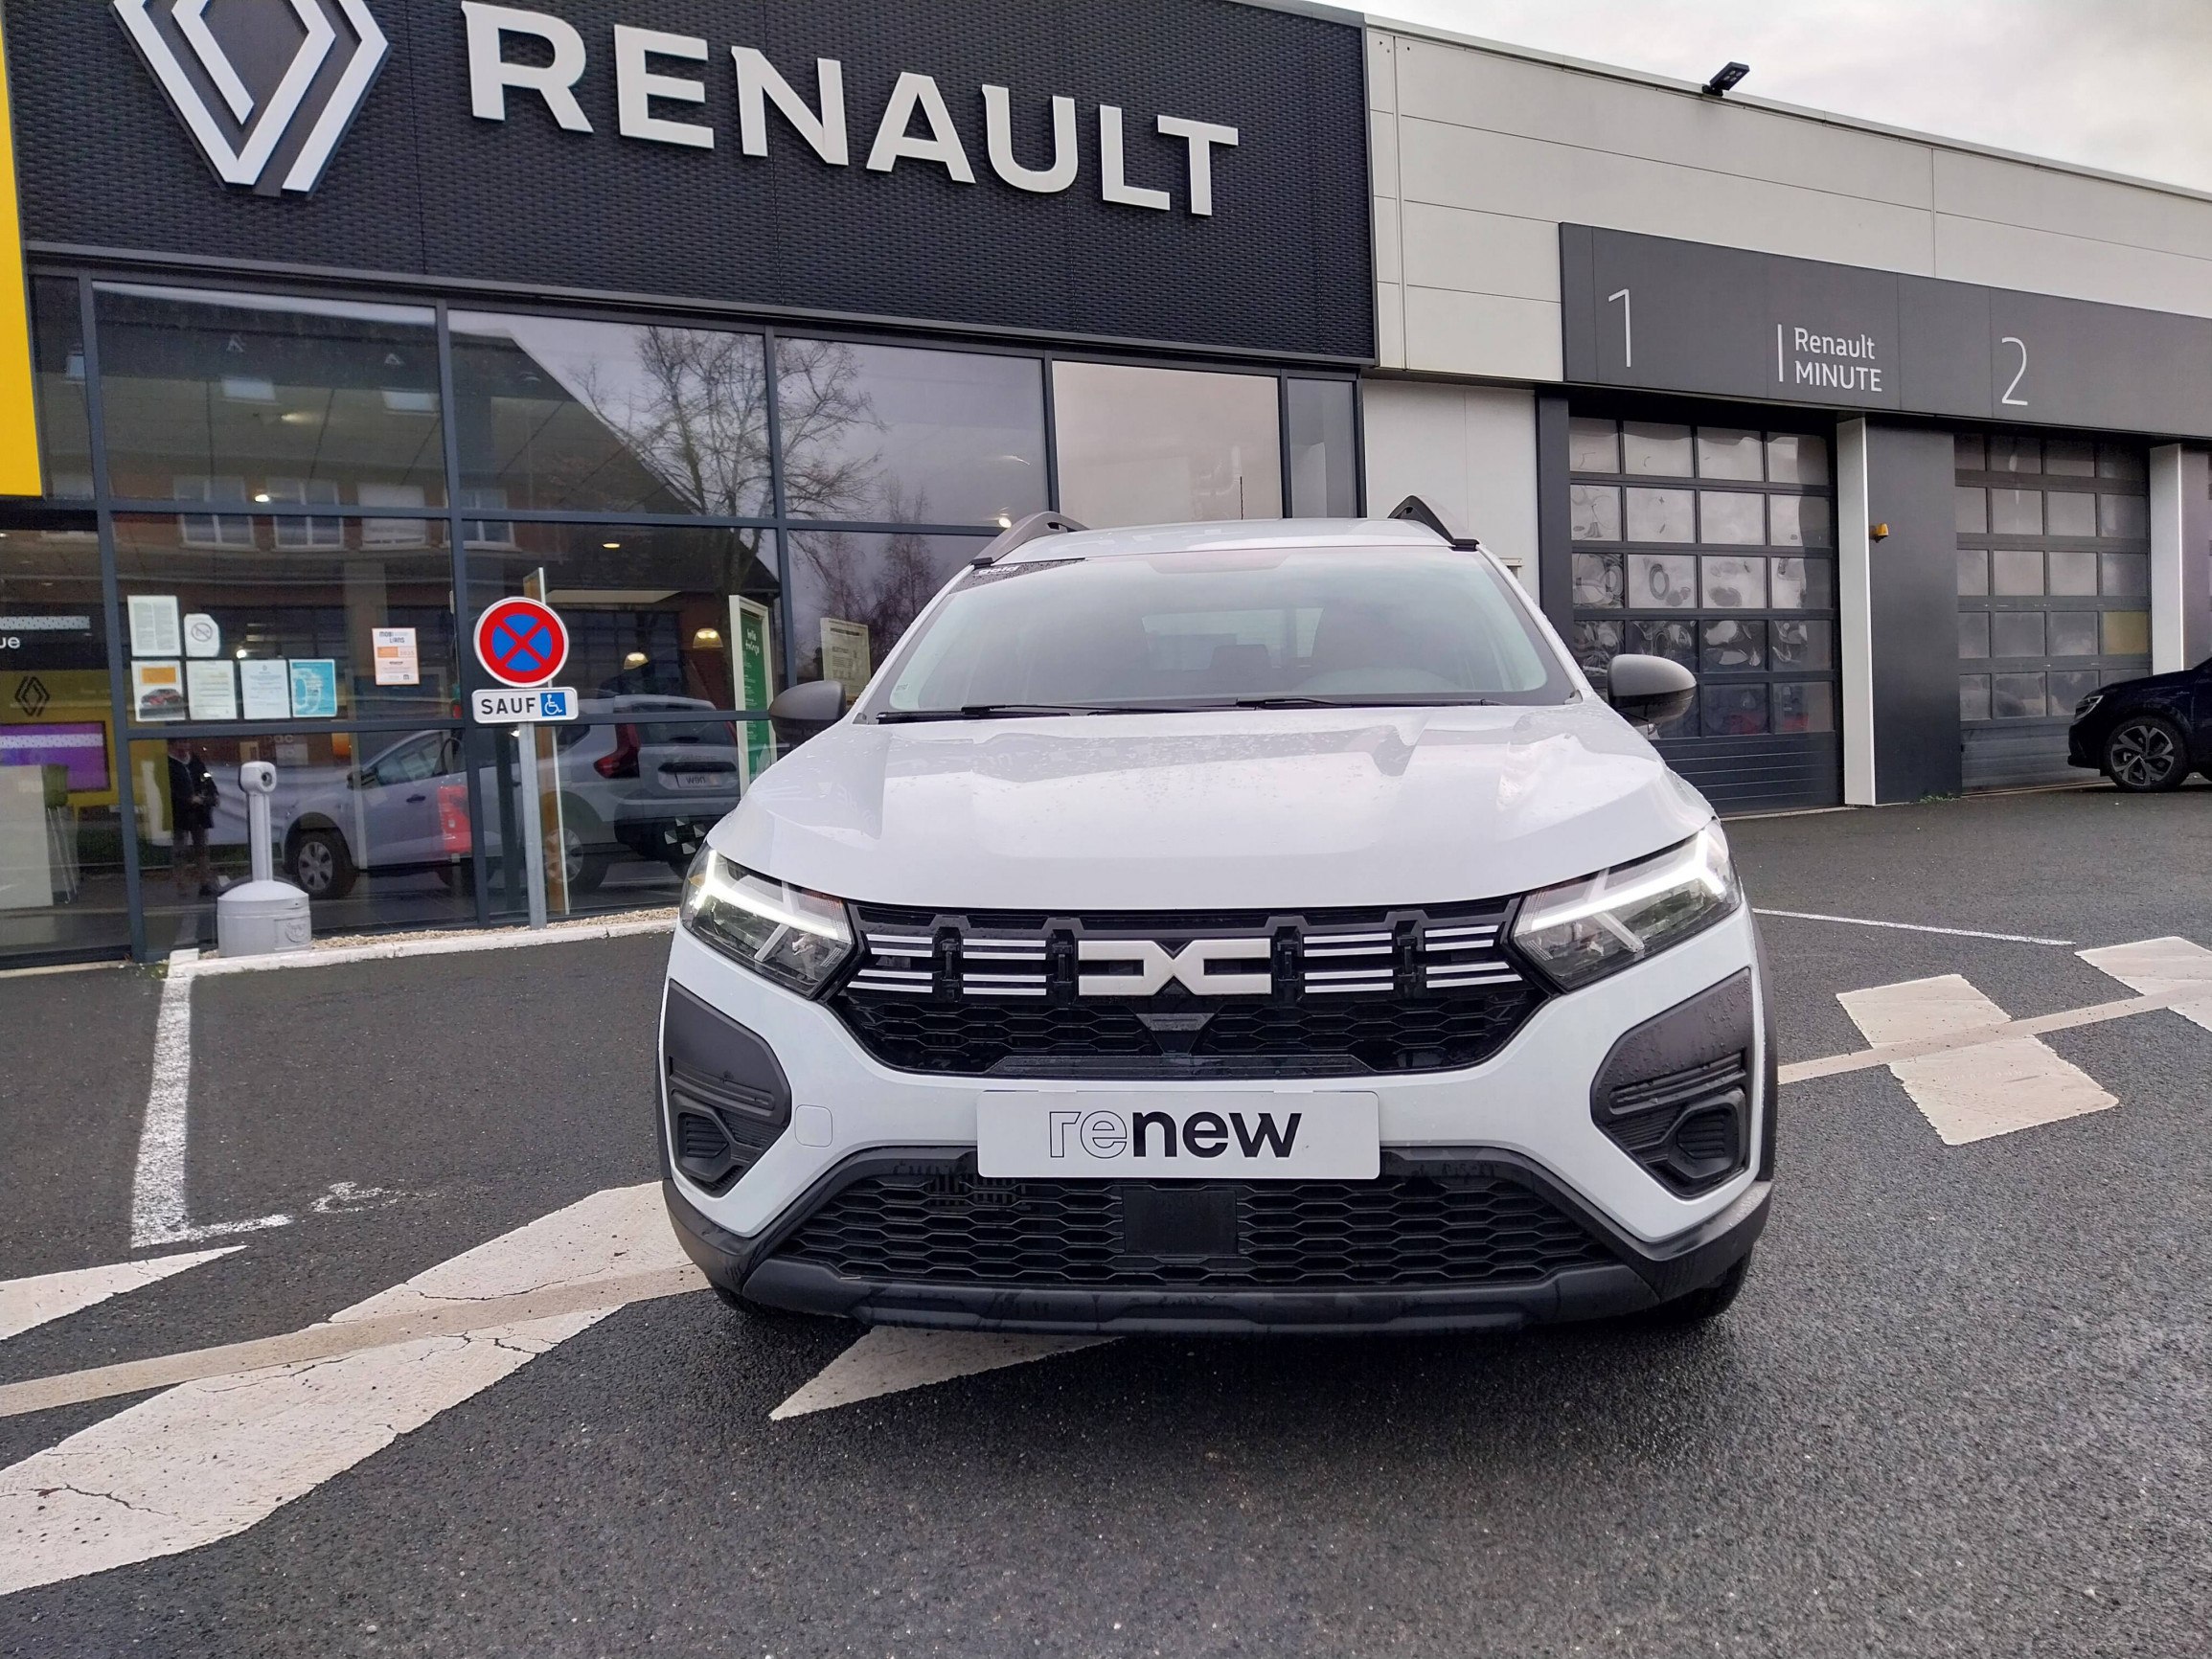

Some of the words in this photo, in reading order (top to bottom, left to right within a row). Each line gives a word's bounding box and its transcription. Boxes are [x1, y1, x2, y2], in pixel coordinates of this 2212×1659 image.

[461, 0, 1239, 216] RENAULT
[1608, 288, 1631, 367] 1
[1793, 327, 1876, 359] Renault
[1794, 360, 1882, 392] MINUTE
[2001, 336, 2028, 406] 2
[481, 697, 536, 715] SAUF
[1049, 1110, 1303, 1159] renew
